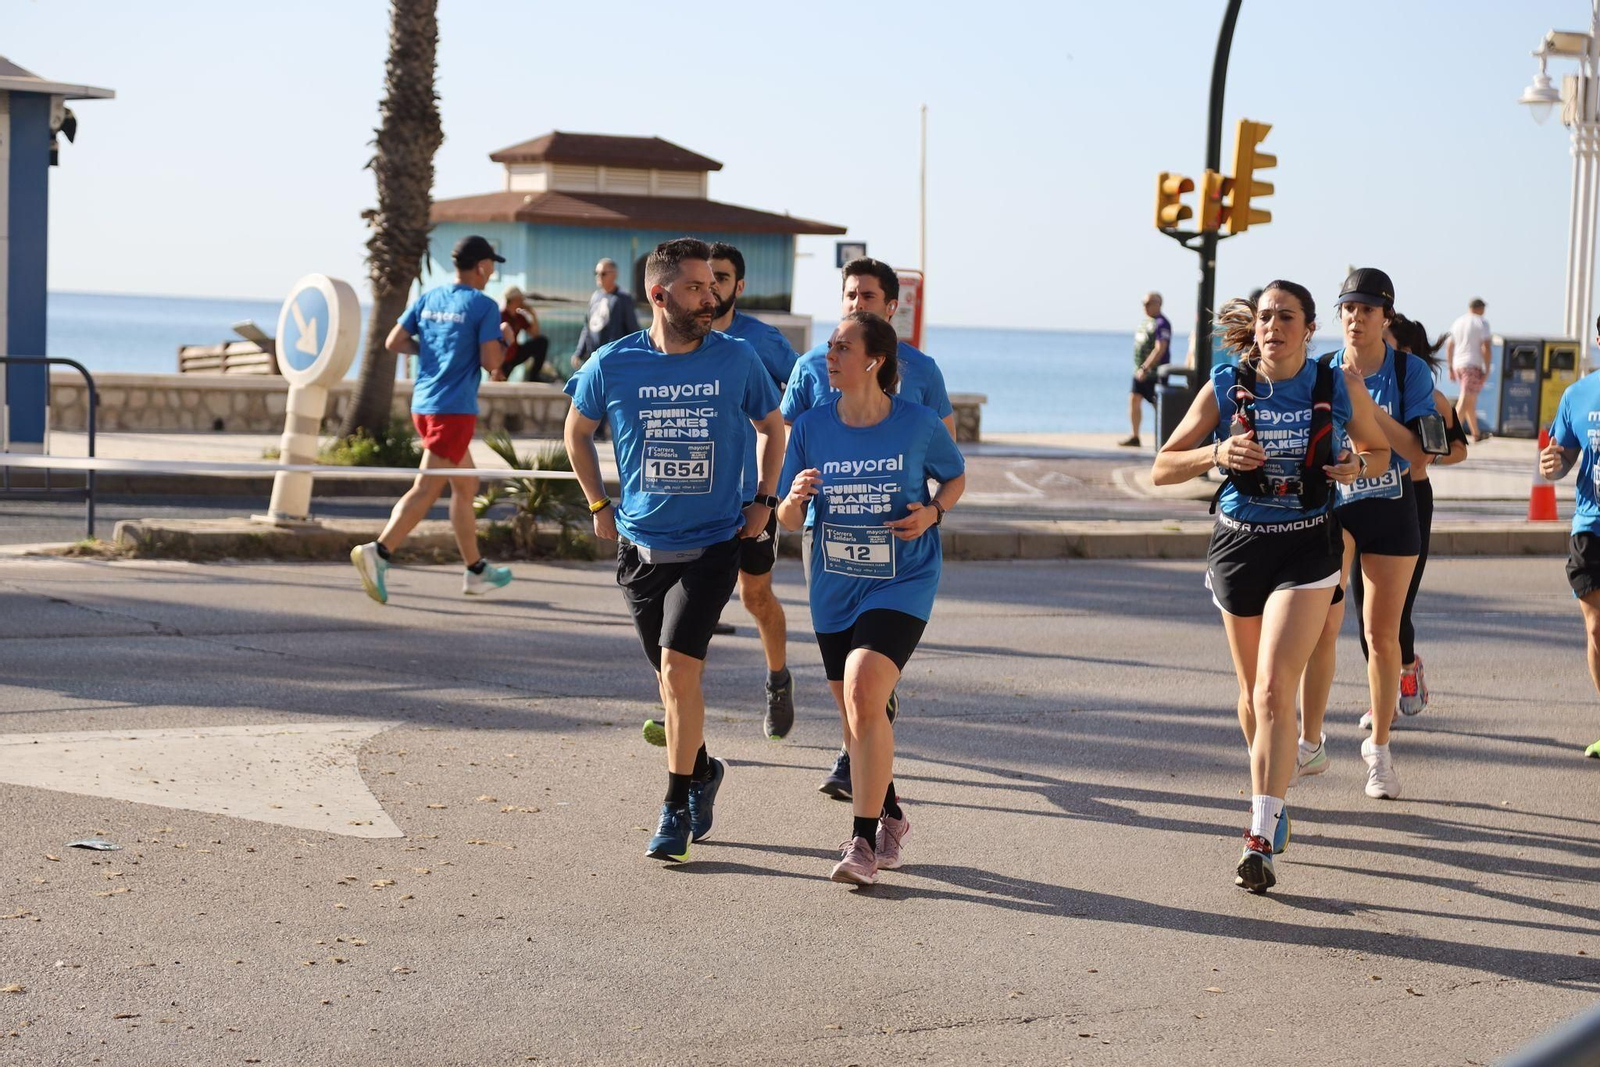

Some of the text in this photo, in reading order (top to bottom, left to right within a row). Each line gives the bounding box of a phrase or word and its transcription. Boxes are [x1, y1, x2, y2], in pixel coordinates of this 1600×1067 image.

[638, 379, 720, 402] mayoral
[638, 407, 714, 420] RUNNING
[1254, 408, 1313, 425] ayora
[646, 418, 708, 429] MAKES
[645, 428, 709, 439] FRIENDS
[1257, 427, 1311, 440] UNNIN
[1258, 438, 1309, 450] AKES
[650, 461, 705, 477] 1654
[823, 454, 903, 477] mayoral
[822, 483, 898, 496] RUNNING
[828, 494, 891, 505] MAKES
[829, 504, 892, 515] FRIENDS
[1253, 515, 1324, 534] ARMOUR
[844, 545, 871, 561] 12
